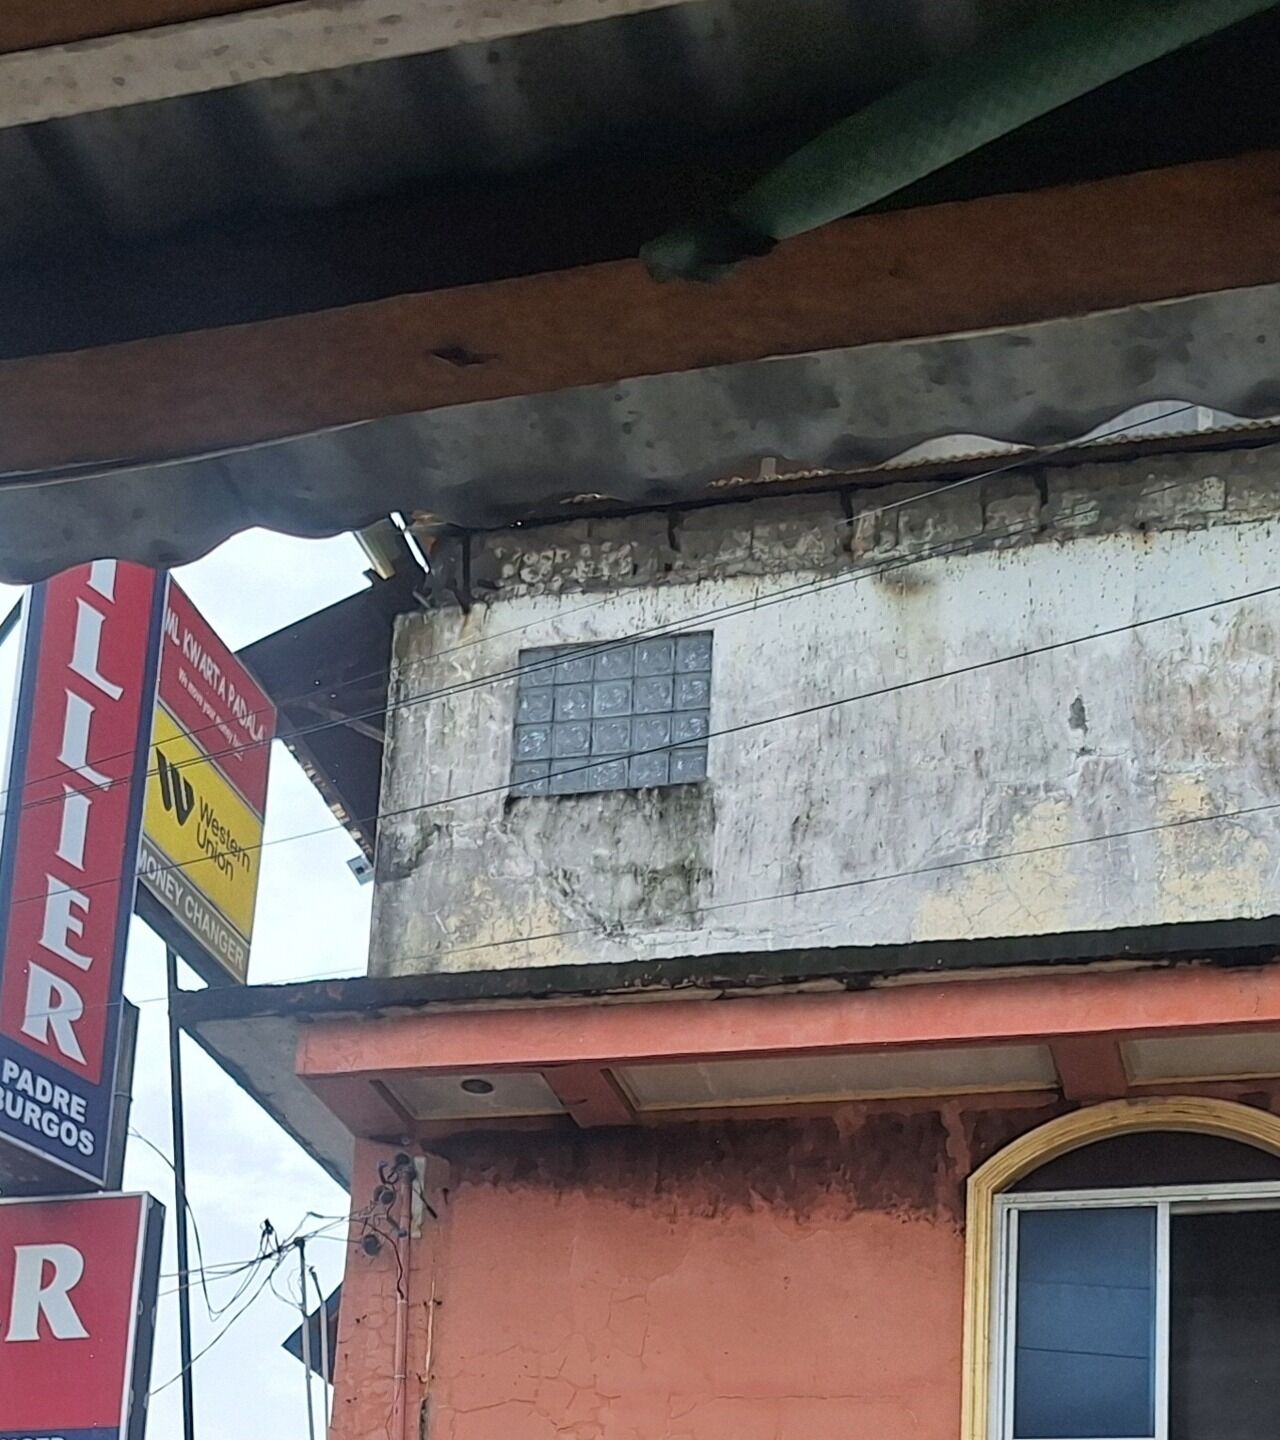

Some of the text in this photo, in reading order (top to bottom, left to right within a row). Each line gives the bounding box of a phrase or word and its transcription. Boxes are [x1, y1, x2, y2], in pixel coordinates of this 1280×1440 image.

[183, 628, 226, 702] KWARTA
[227, 683, 265, 742] PADALA
[196, 822, 234, 881] Union
[199, 796, 251, 873] Western
[138, 850, 244, 972] MONEY CHANGER
[2, 1058, 87, 1124] PADRE
